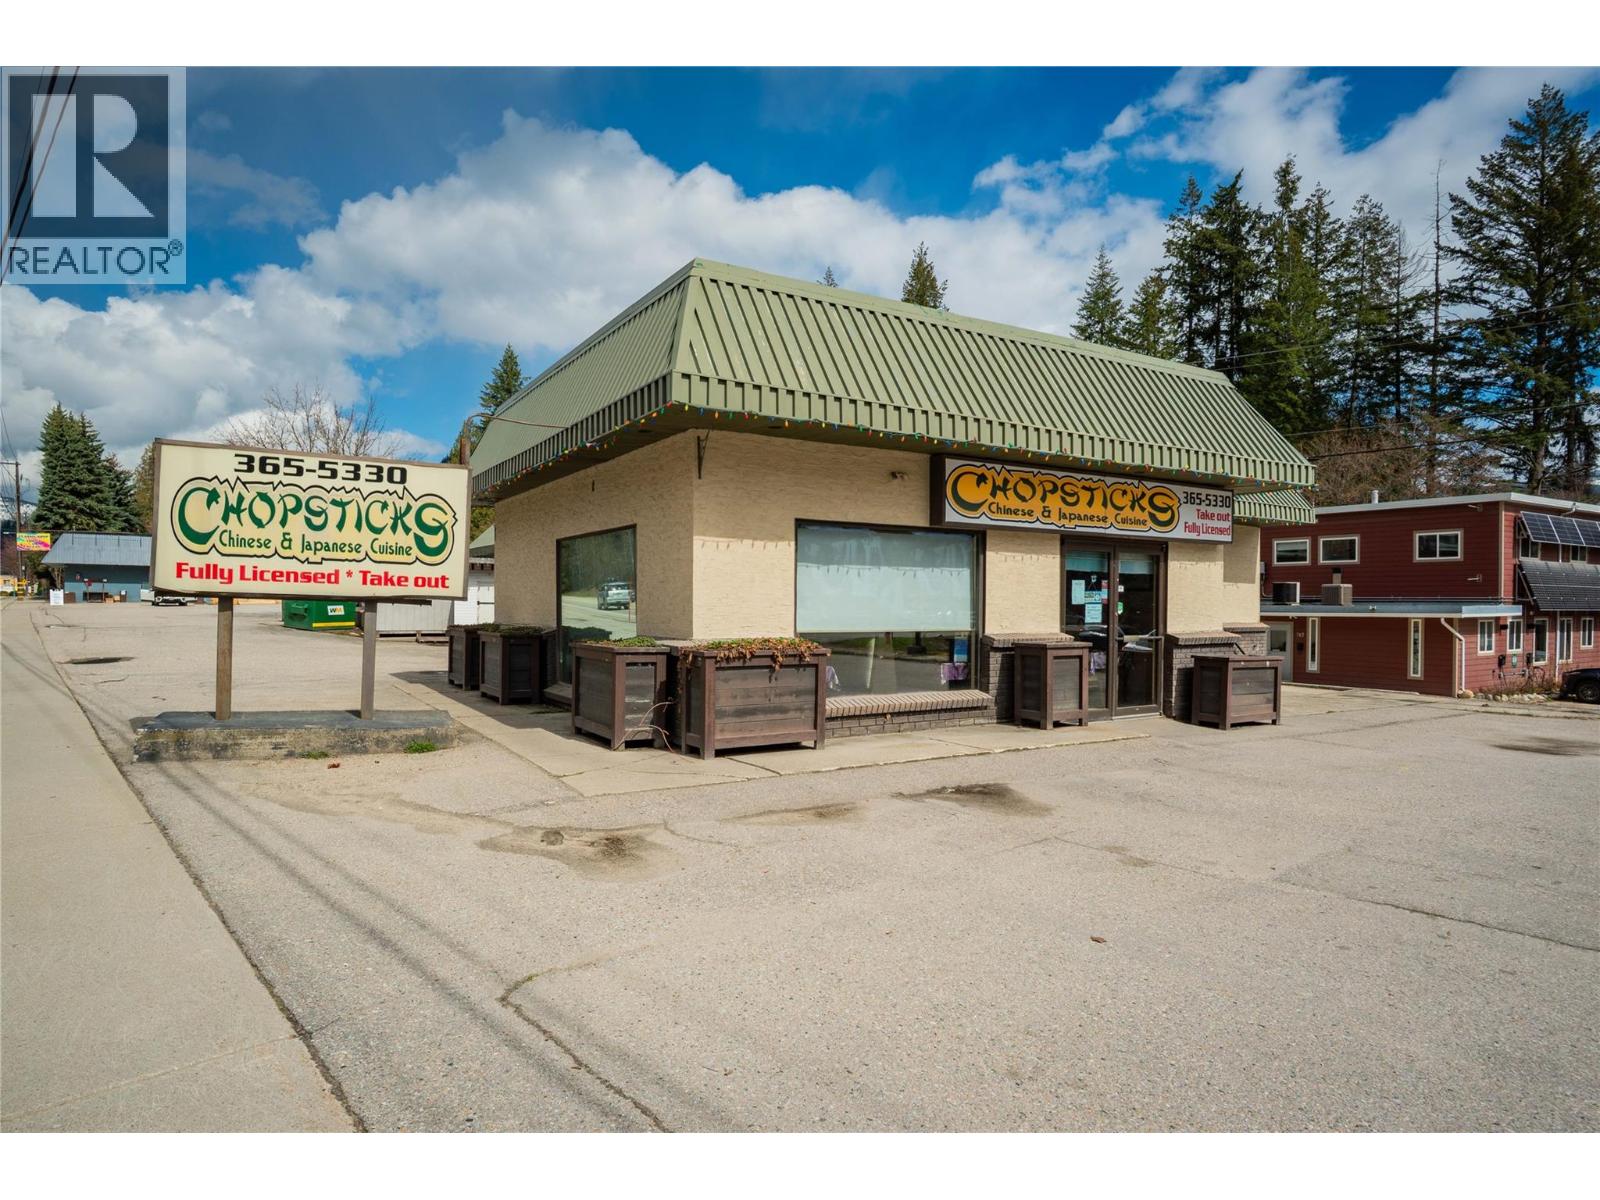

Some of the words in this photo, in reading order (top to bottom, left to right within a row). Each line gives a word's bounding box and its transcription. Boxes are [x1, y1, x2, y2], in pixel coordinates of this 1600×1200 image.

[234, 453, 407, 485] 365-5330
[951, 471, 1175, 527] CHOPSTICKS
[1182, 491, 1231, 508] 365-5330
[178, 486, 449, 557] CHOPSTICKS
[988, 502, 1034, 517] Chinese
[1041, 505, 1051, 518] &
[1058, 507, 1108, 524] Japanese
[1115, 513, 1148, 527] Cuisine
[1196, 508, 1215, 521] Take
[1216, 512, 1230, 522] out
[1184, 521, 1200, 536] Fully
[1201, 523, 1231, 536] Licensed
[219, 529, 272, 549] Chinese
[280, 532, 292, 549] &
[301, 533, 362, 555] Japanese
[370, 538, 413, 557] Cuisine
[176, 562, 233, 585] Fully
[239, 565, 340, 585] Licensed
[359, 570, 409, 588] Take
[413, 574, 450, 589] out
